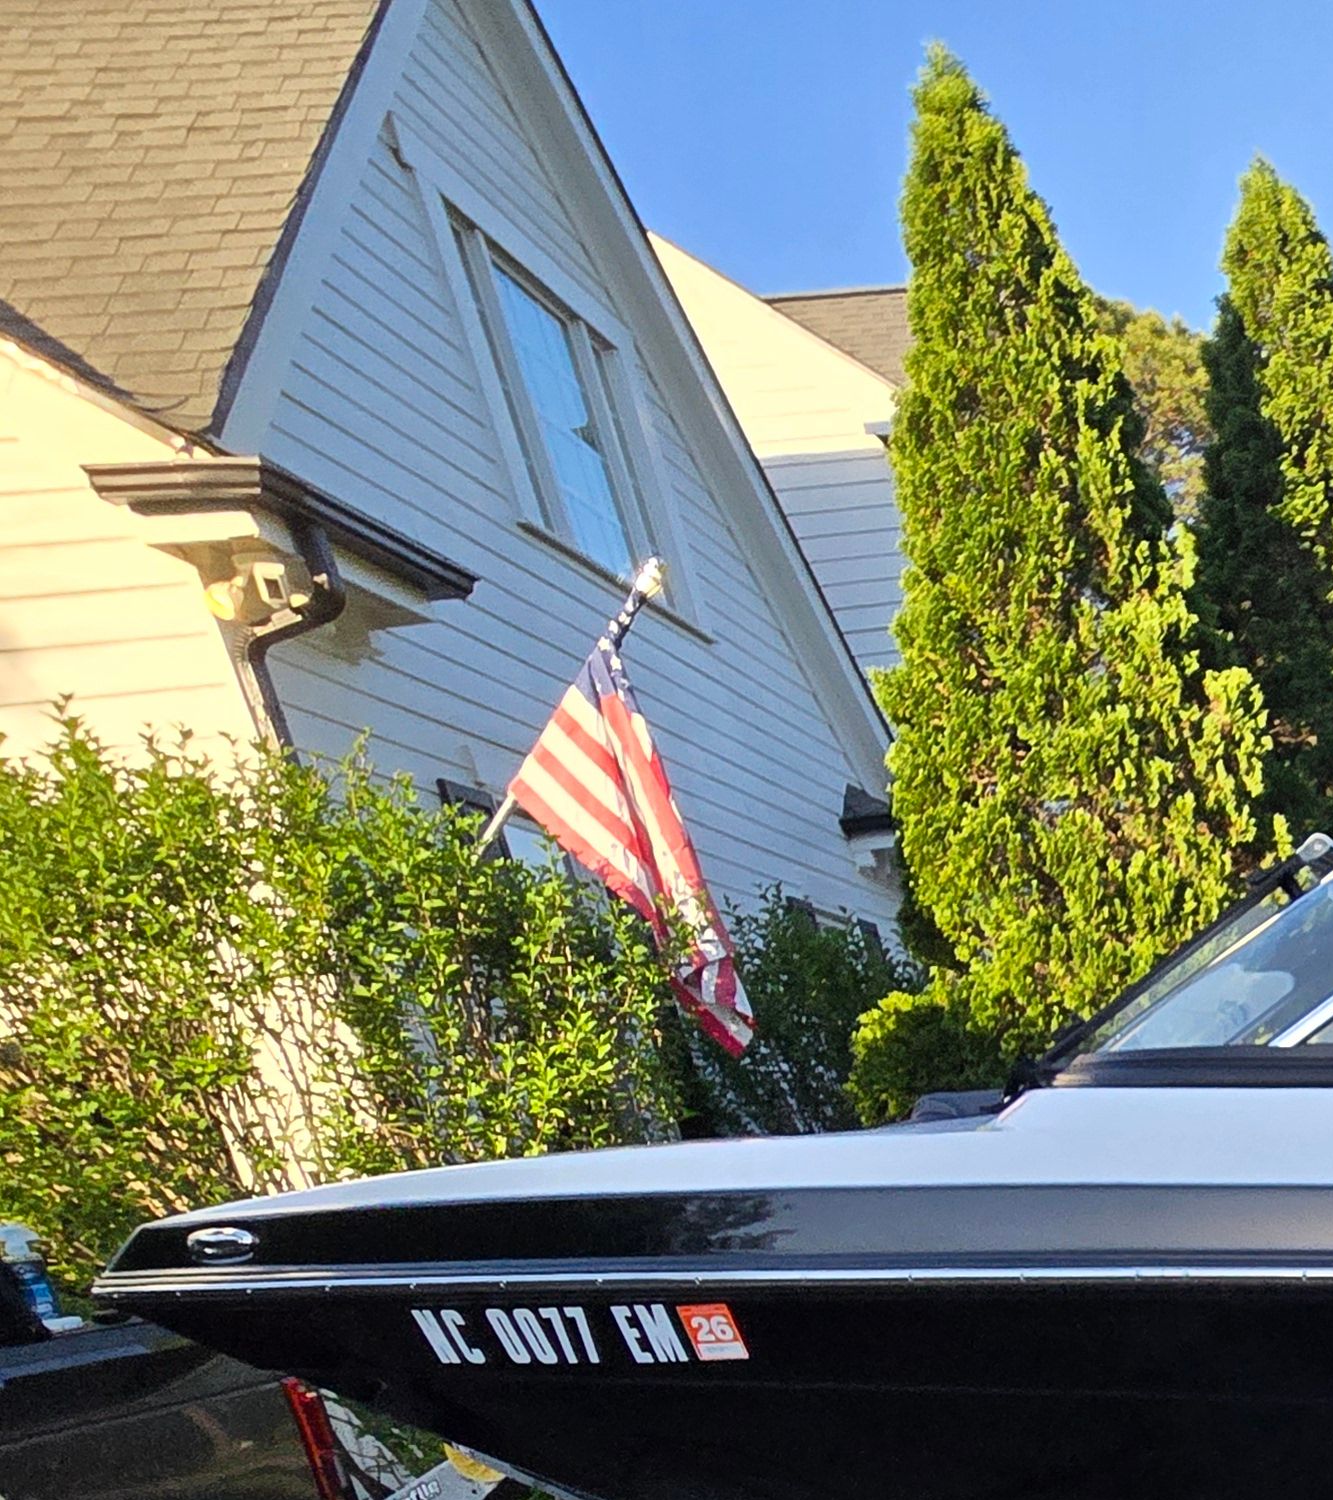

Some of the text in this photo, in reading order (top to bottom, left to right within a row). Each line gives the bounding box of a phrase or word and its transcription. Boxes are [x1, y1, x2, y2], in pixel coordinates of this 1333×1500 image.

[411, 1303, 689, 1364] NC 0077 EM
[690, 1314, 735, 1342] 26
